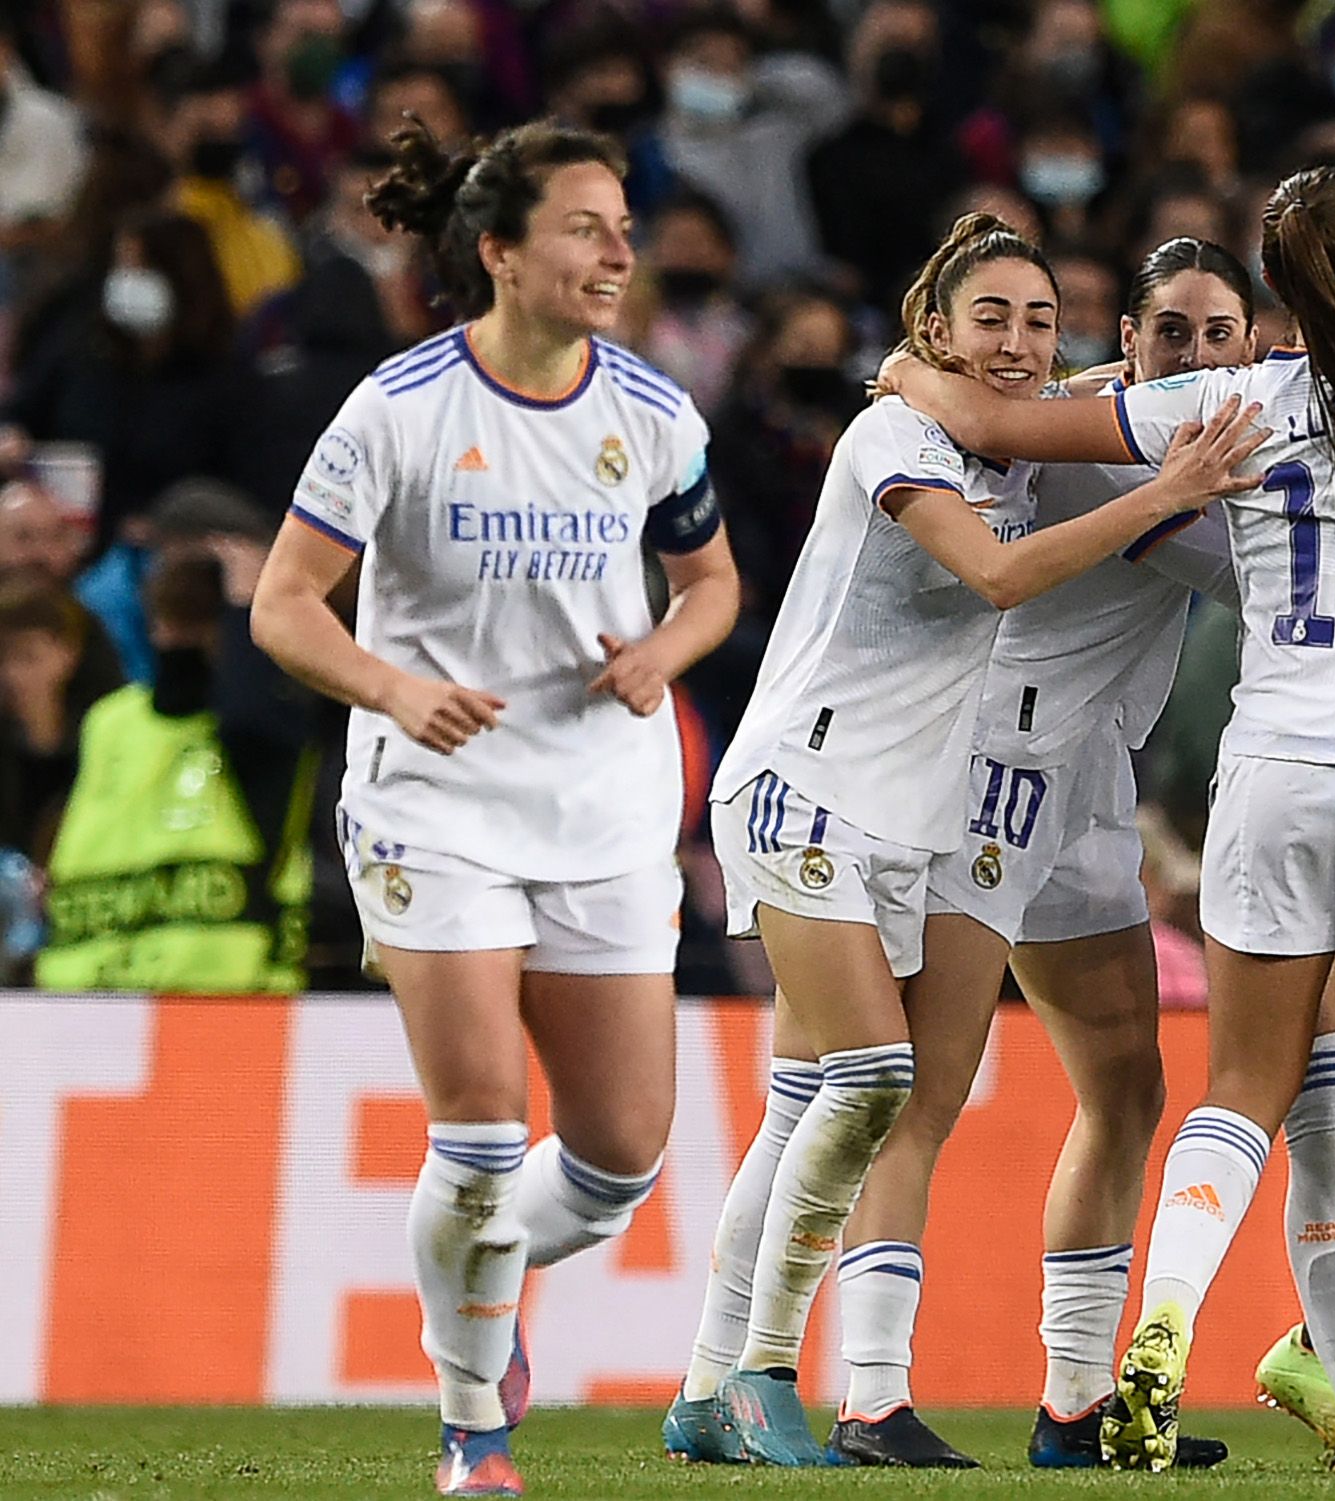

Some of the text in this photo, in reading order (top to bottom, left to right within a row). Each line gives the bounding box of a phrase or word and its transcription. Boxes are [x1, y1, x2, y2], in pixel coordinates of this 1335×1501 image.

[449, 502, 629, 543] Emirates
[478, 550, 608, 581] FLY BETTER
[968, 755, 1048, 850] 10
[1165, 1198, 1226, 1222] adidas
